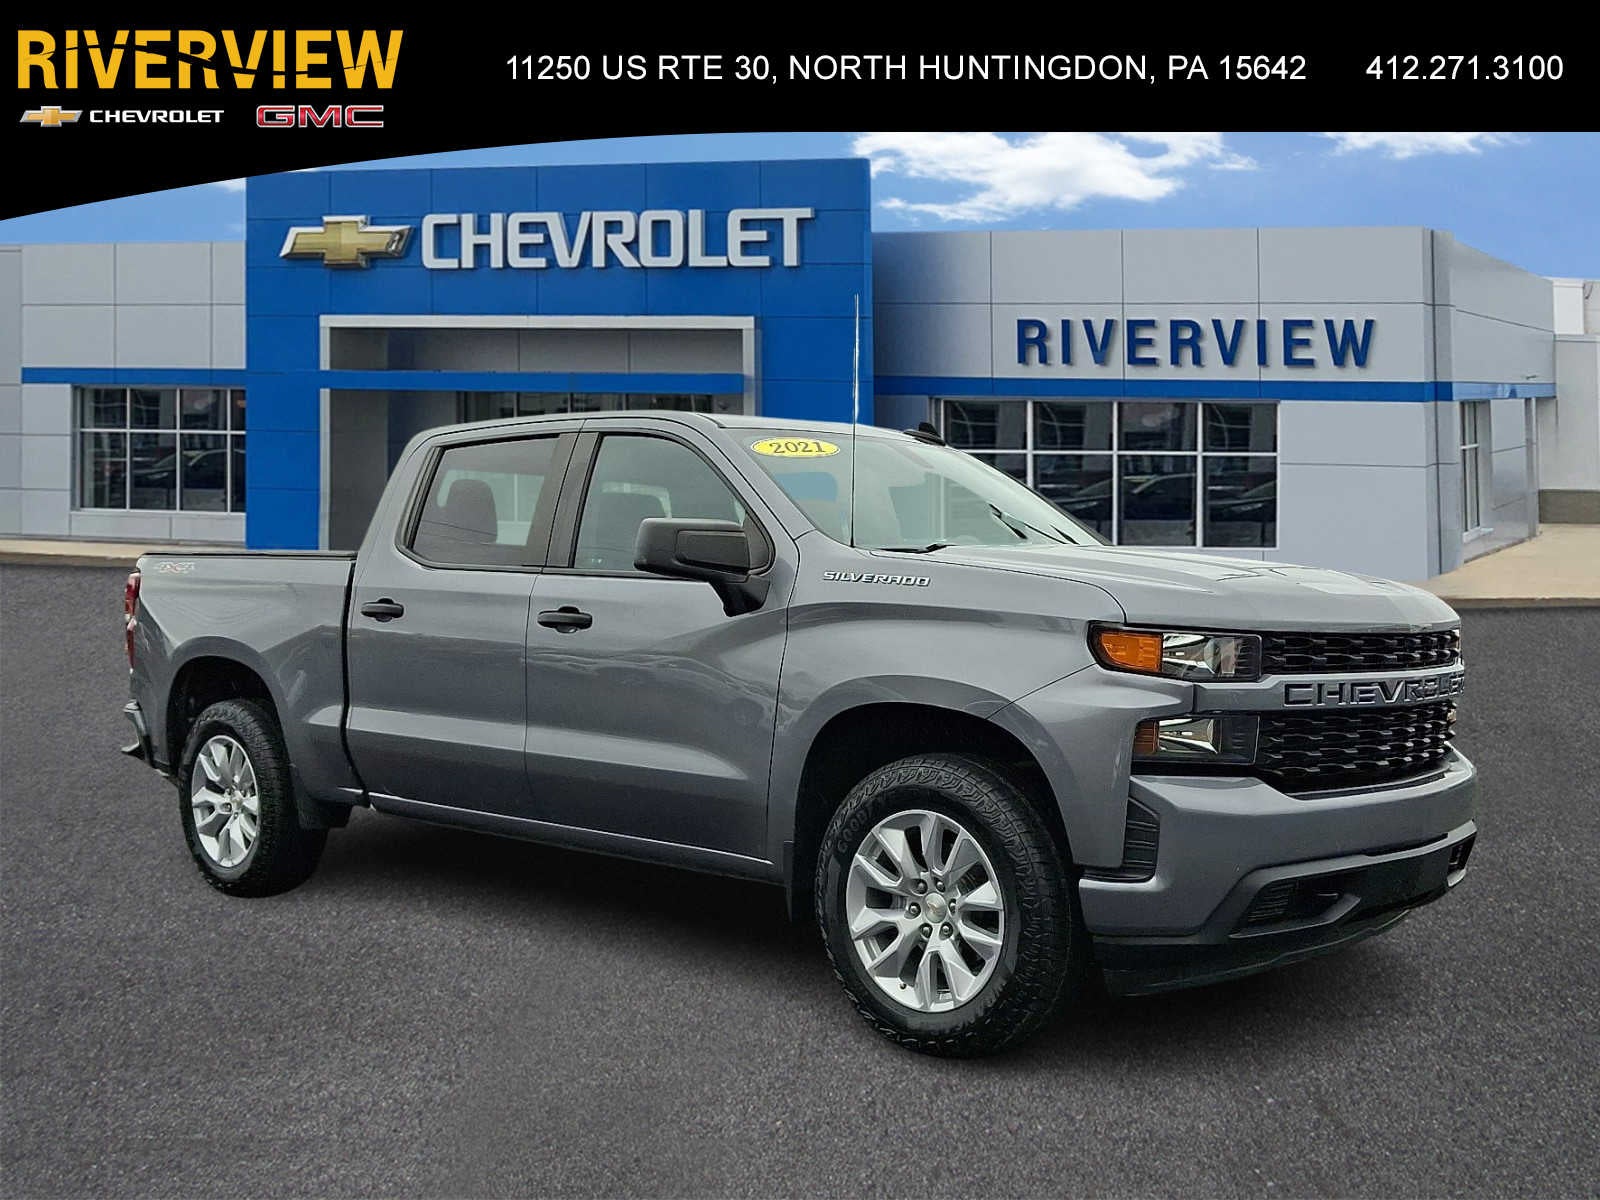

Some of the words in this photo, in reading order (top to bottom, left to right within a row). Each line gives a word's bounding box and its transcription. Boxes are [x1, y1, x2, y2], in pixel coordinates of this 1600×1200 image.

[422, 208, 814, 269] CHEVROLET
[1017, 319, 1375, 367] RIVERVIEW
[769, 441, 825, 454] 2021
[823, 571, 931, 587] SILVERADO
